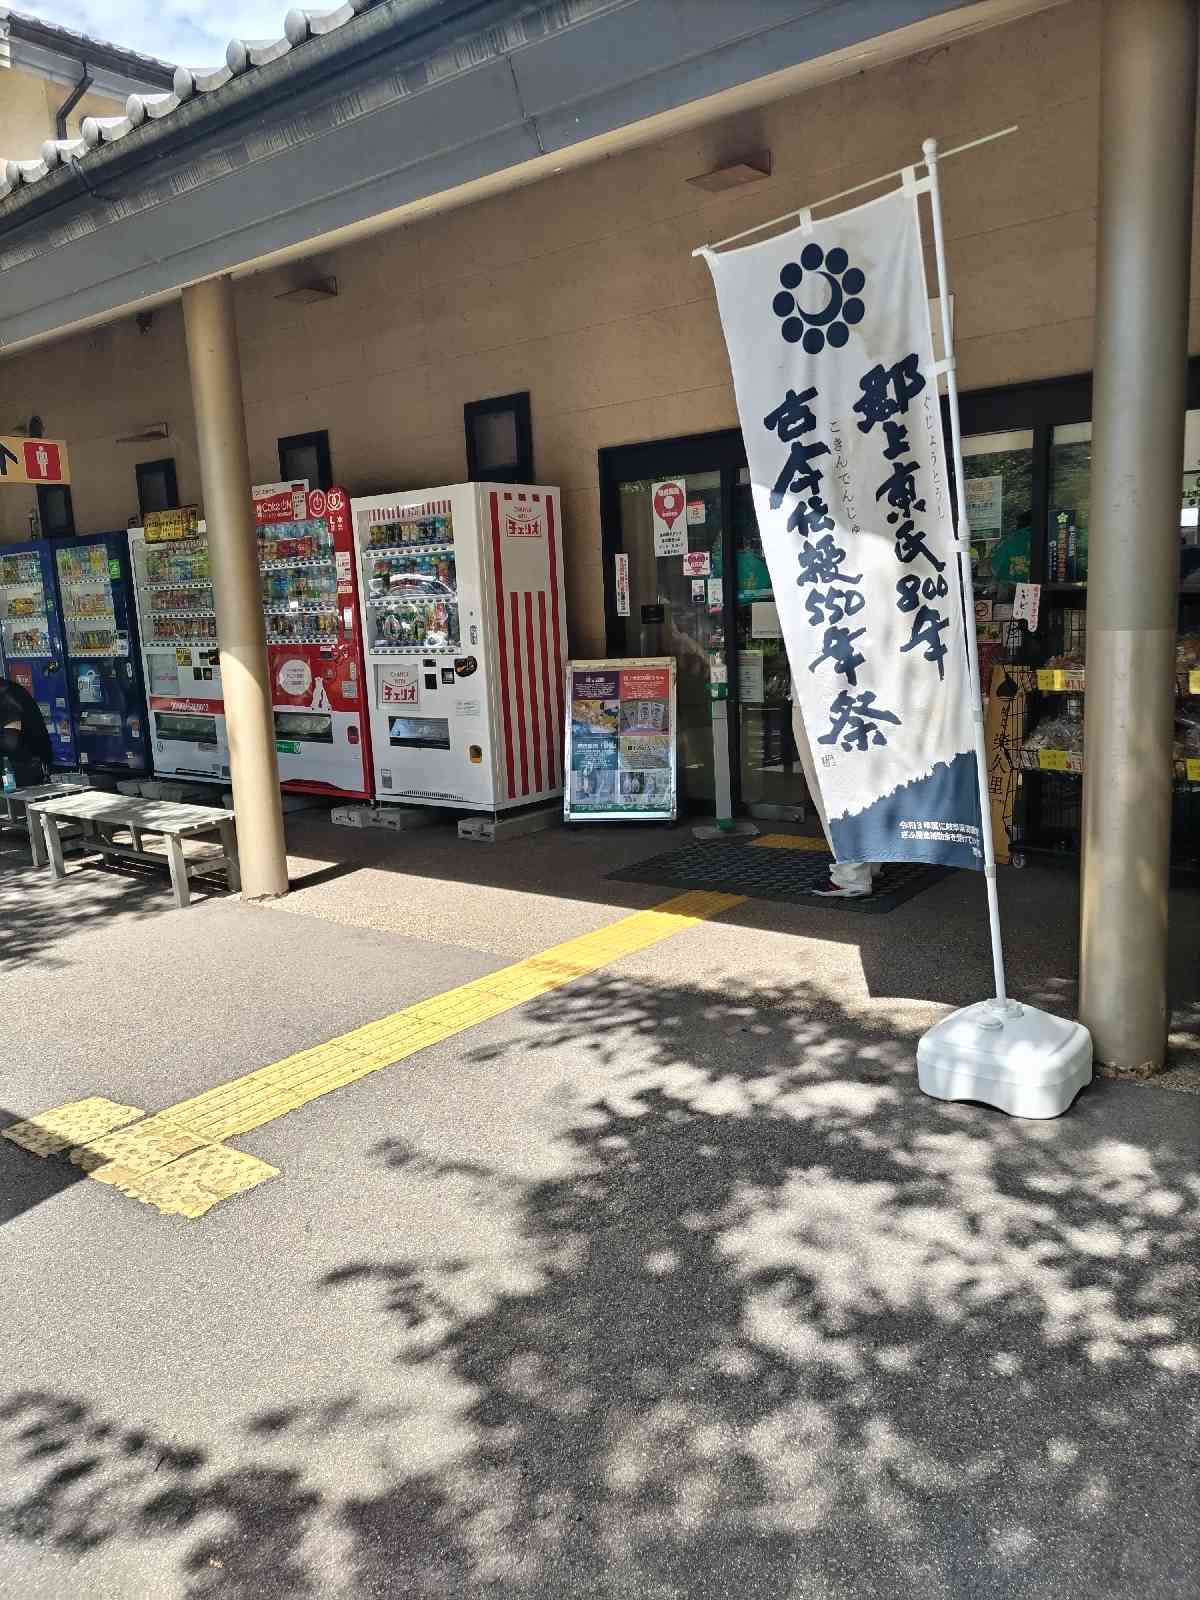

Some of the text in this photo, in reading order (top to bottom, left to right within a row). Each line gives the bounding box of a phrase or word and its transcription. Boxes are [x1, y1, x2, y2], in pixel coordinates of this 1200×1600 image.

[763, 386, 903, 752] 古今伝授550年祭
[853, 353, 949, 681] 郡上東氏800年
[383, 684, 417, 701] チェリオ
